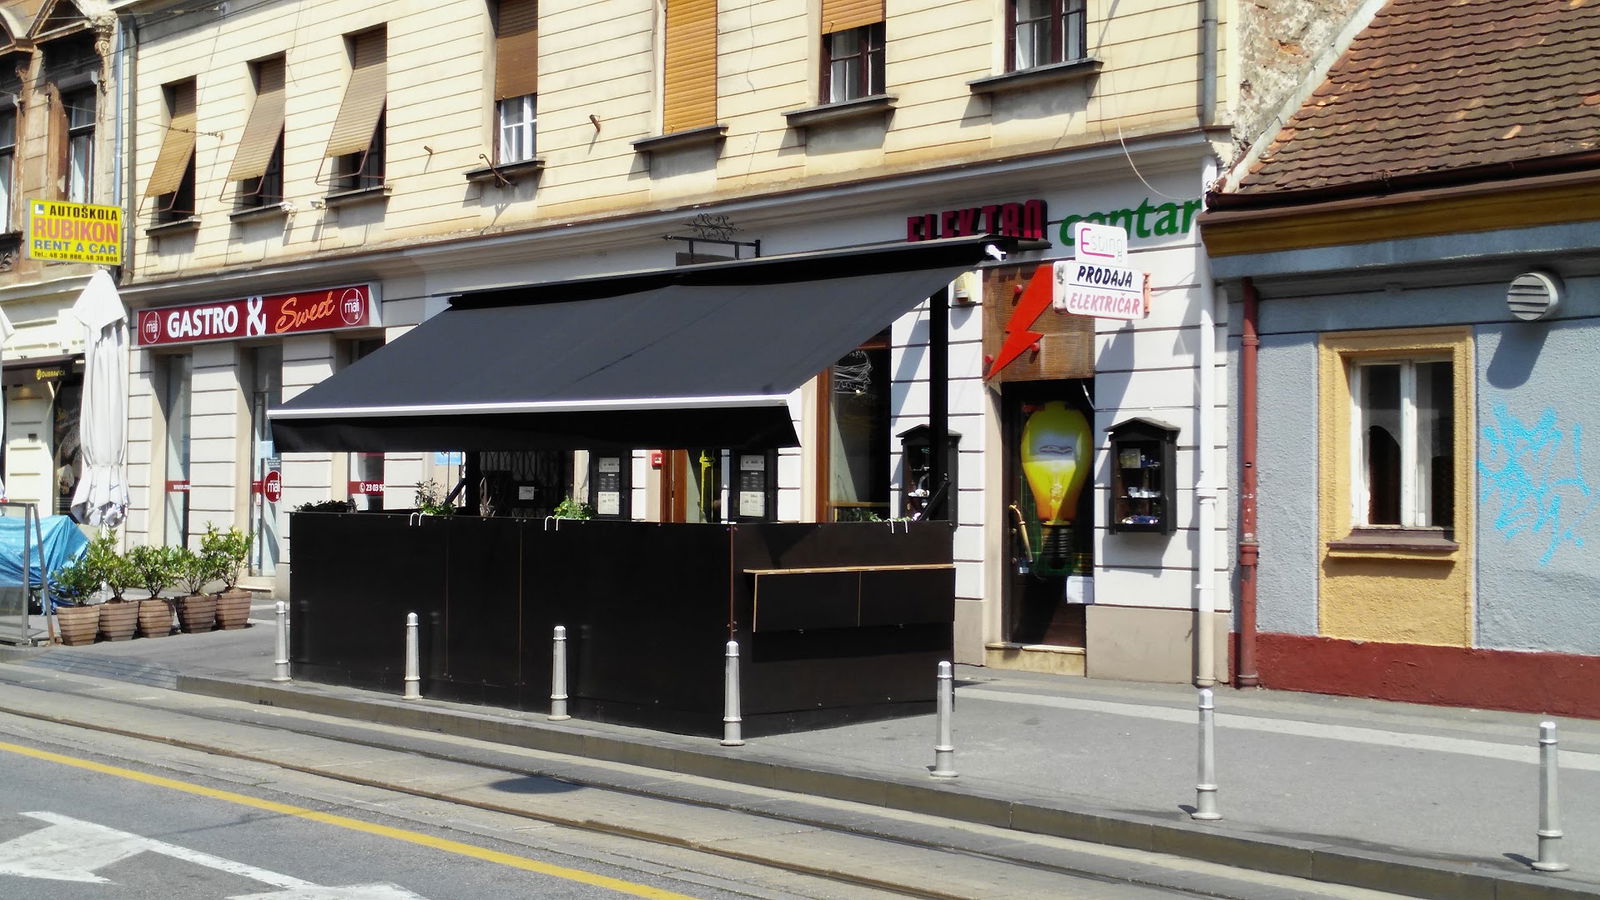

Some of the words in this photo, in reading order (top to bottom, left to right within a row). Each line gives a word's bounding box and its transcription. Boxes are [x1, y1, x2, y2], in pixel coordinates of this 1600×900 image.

[49, 204, 118, 221] AUTOŠKOLA
[907, 199, 1046, 242] ELEKTRO
[33, 217, 119, 244] RUBIKON
[34, 240, 71, 252] RENT
[76, 242, 84, 253] A
[89, 243, 117, 255] CAR
[1077, 265, 1133, 288] PRODAJA
[167, 305, 238, 338] GASTRO
[247, 296, 266, 336] &
[275, 291, 336, 333] Sweet
[1069, 292, 1140, 315] ELEKTRIČAR
